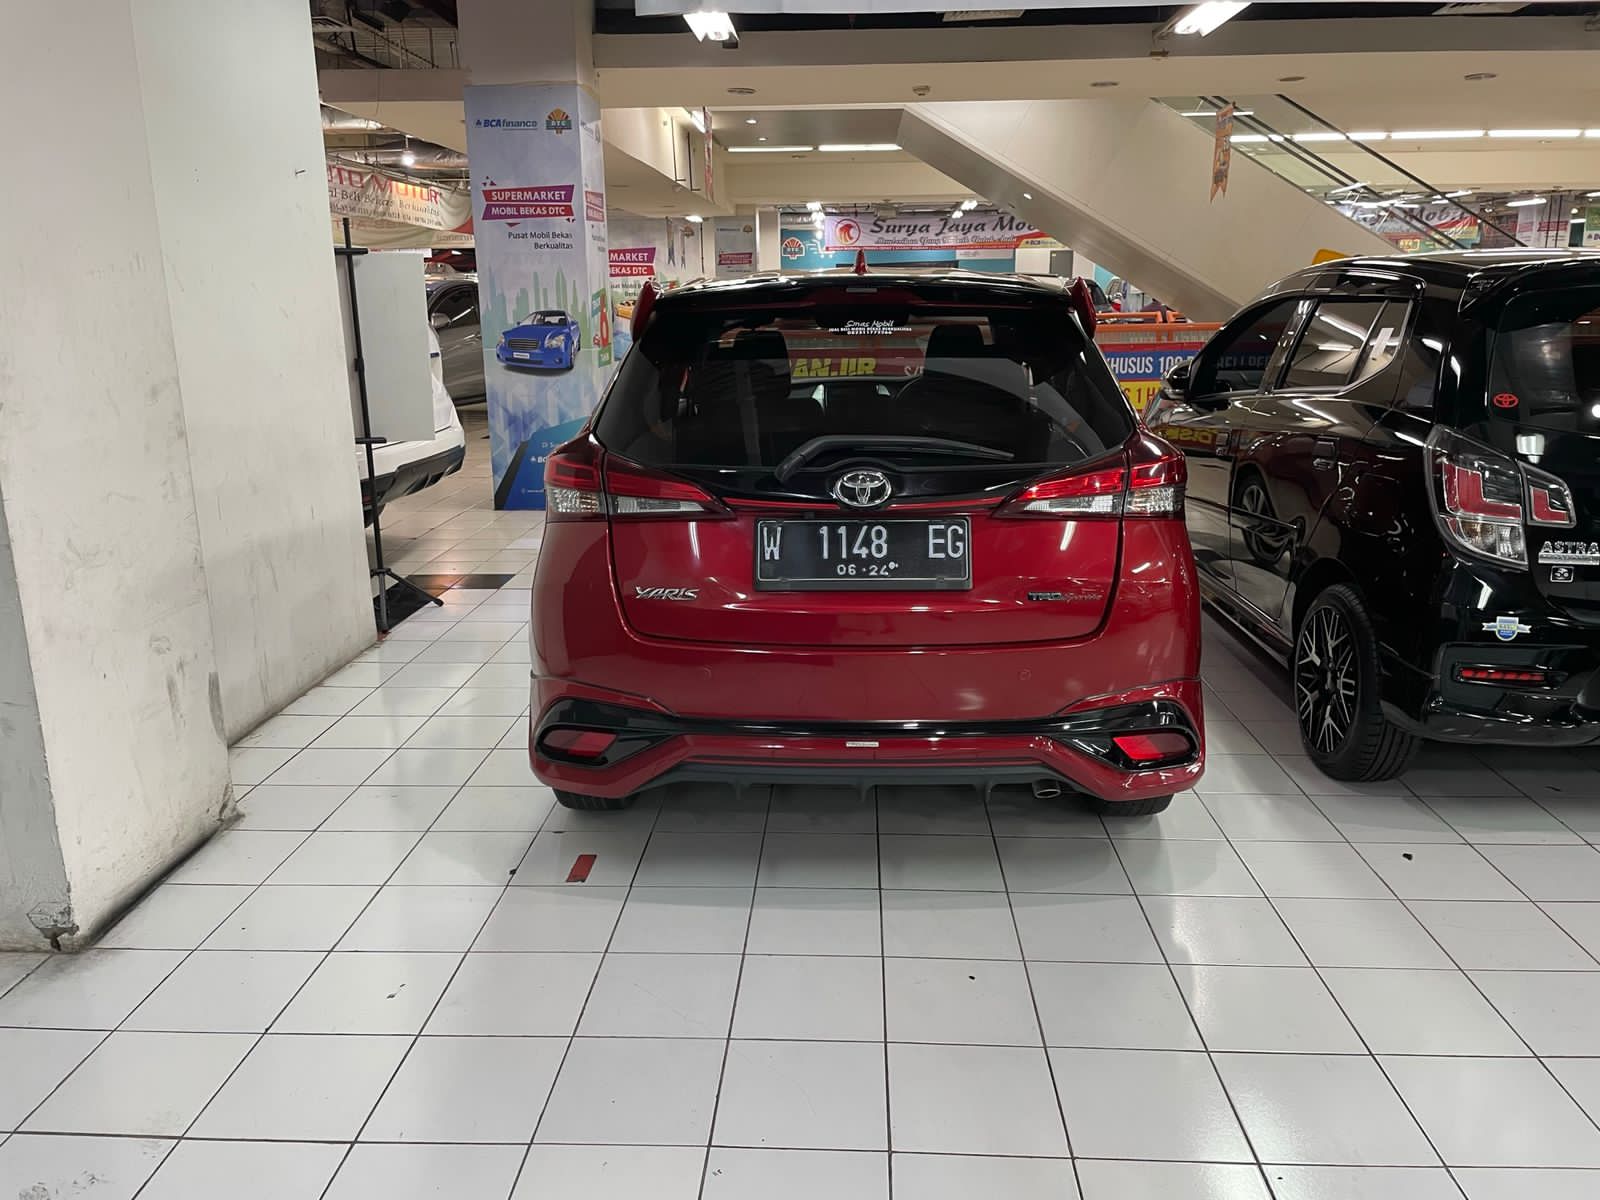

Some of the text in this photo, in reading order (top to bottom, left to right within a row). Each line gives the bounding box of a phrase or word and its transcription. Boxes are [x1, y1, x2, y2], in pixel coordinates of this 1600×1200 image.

[491, 191, 566, 201] SUPERMARKET
[491, 206, 566, 216] MOBIL BEKAS DTC
[870, 219, 930, 237] Surya
[935, 218, 986, 237] Jaya
[508, 230, 573, 239] Pusat Mobil Bekas
[534, 241, 574, 250] Berkualitas
[632, 266, 648, 274] DTC
[763, 524, 964, 560] W 1148 EG
[1541, 541, 1600, 554] ASTRA
[635, 586, 700, 600] YARIS
